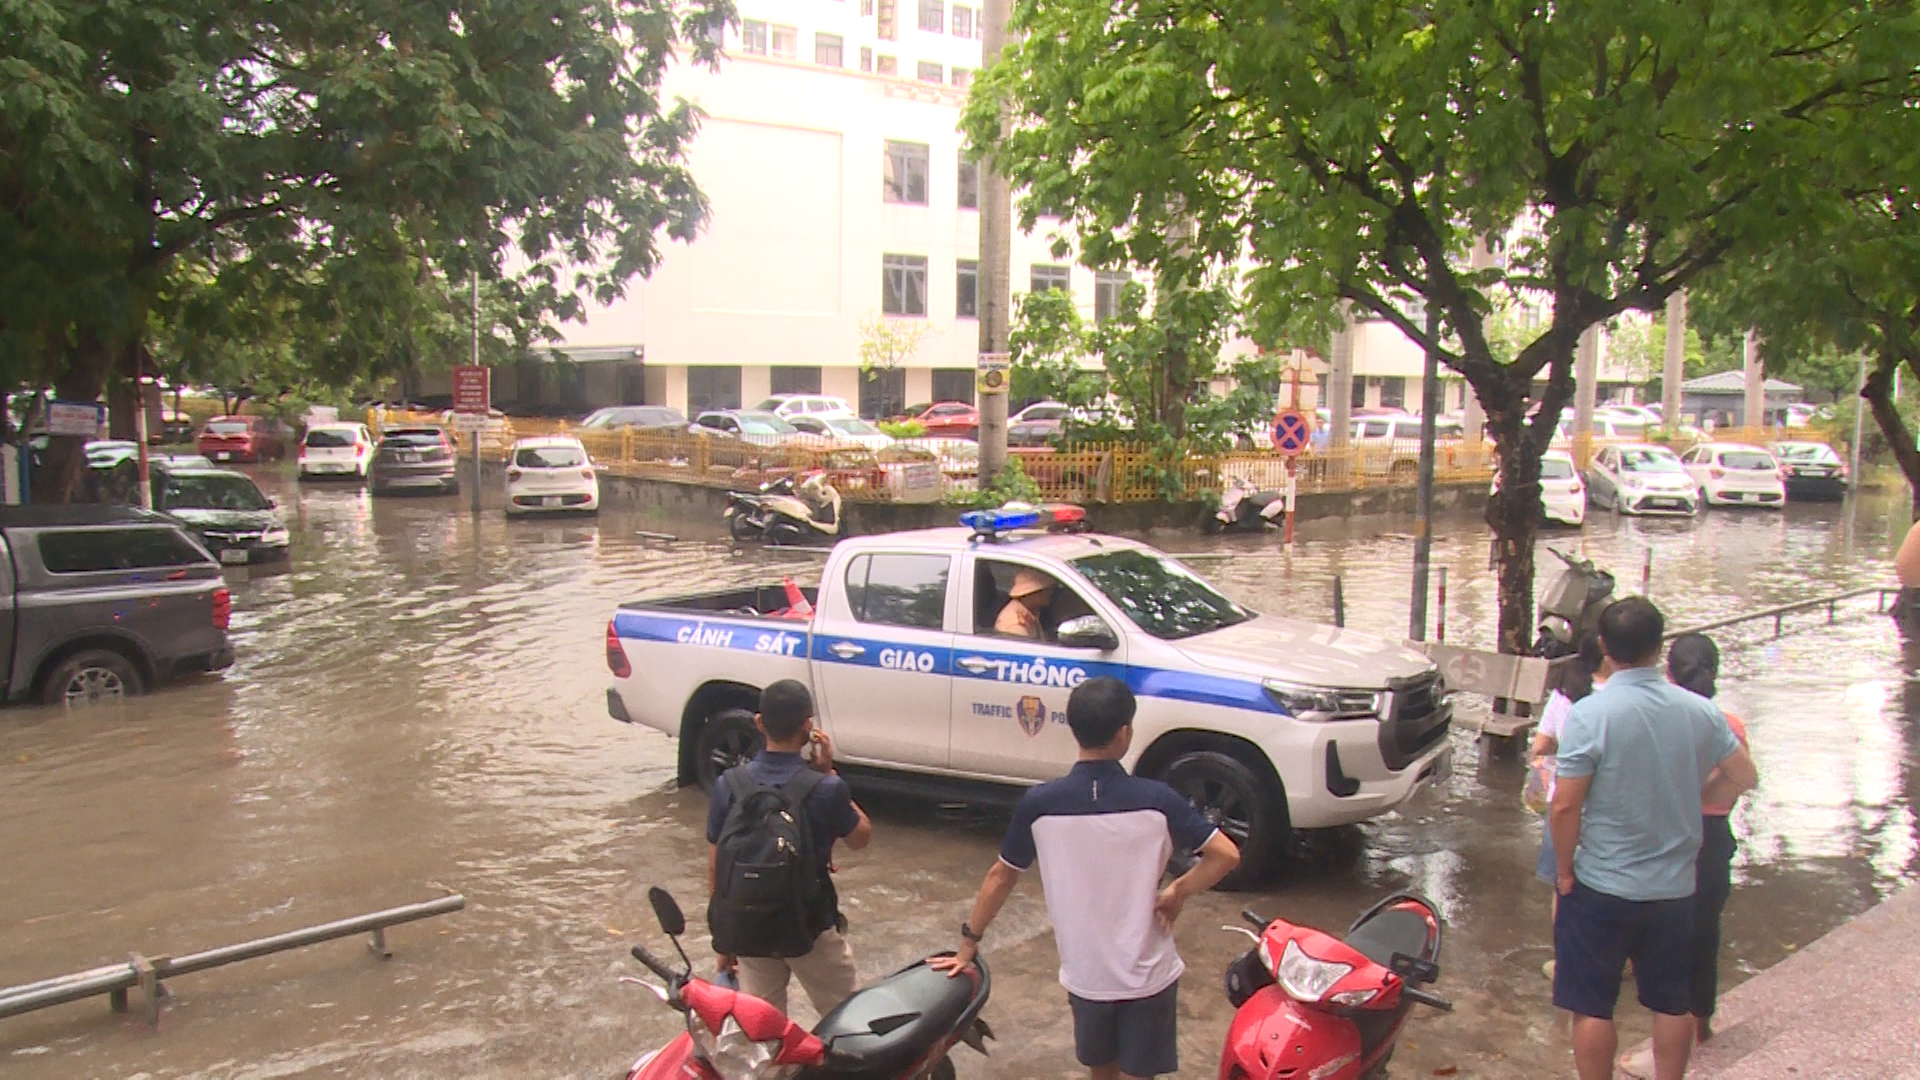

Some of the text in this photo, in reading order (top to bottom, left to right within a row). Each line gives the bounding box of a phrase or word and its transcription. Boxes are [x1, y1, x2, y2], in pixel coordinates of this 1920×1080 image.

[677, 621, 1089, 688] CẢNH SÁT GIAO THÔNG
[972, 702, 1012, 719] TRAFFIC
